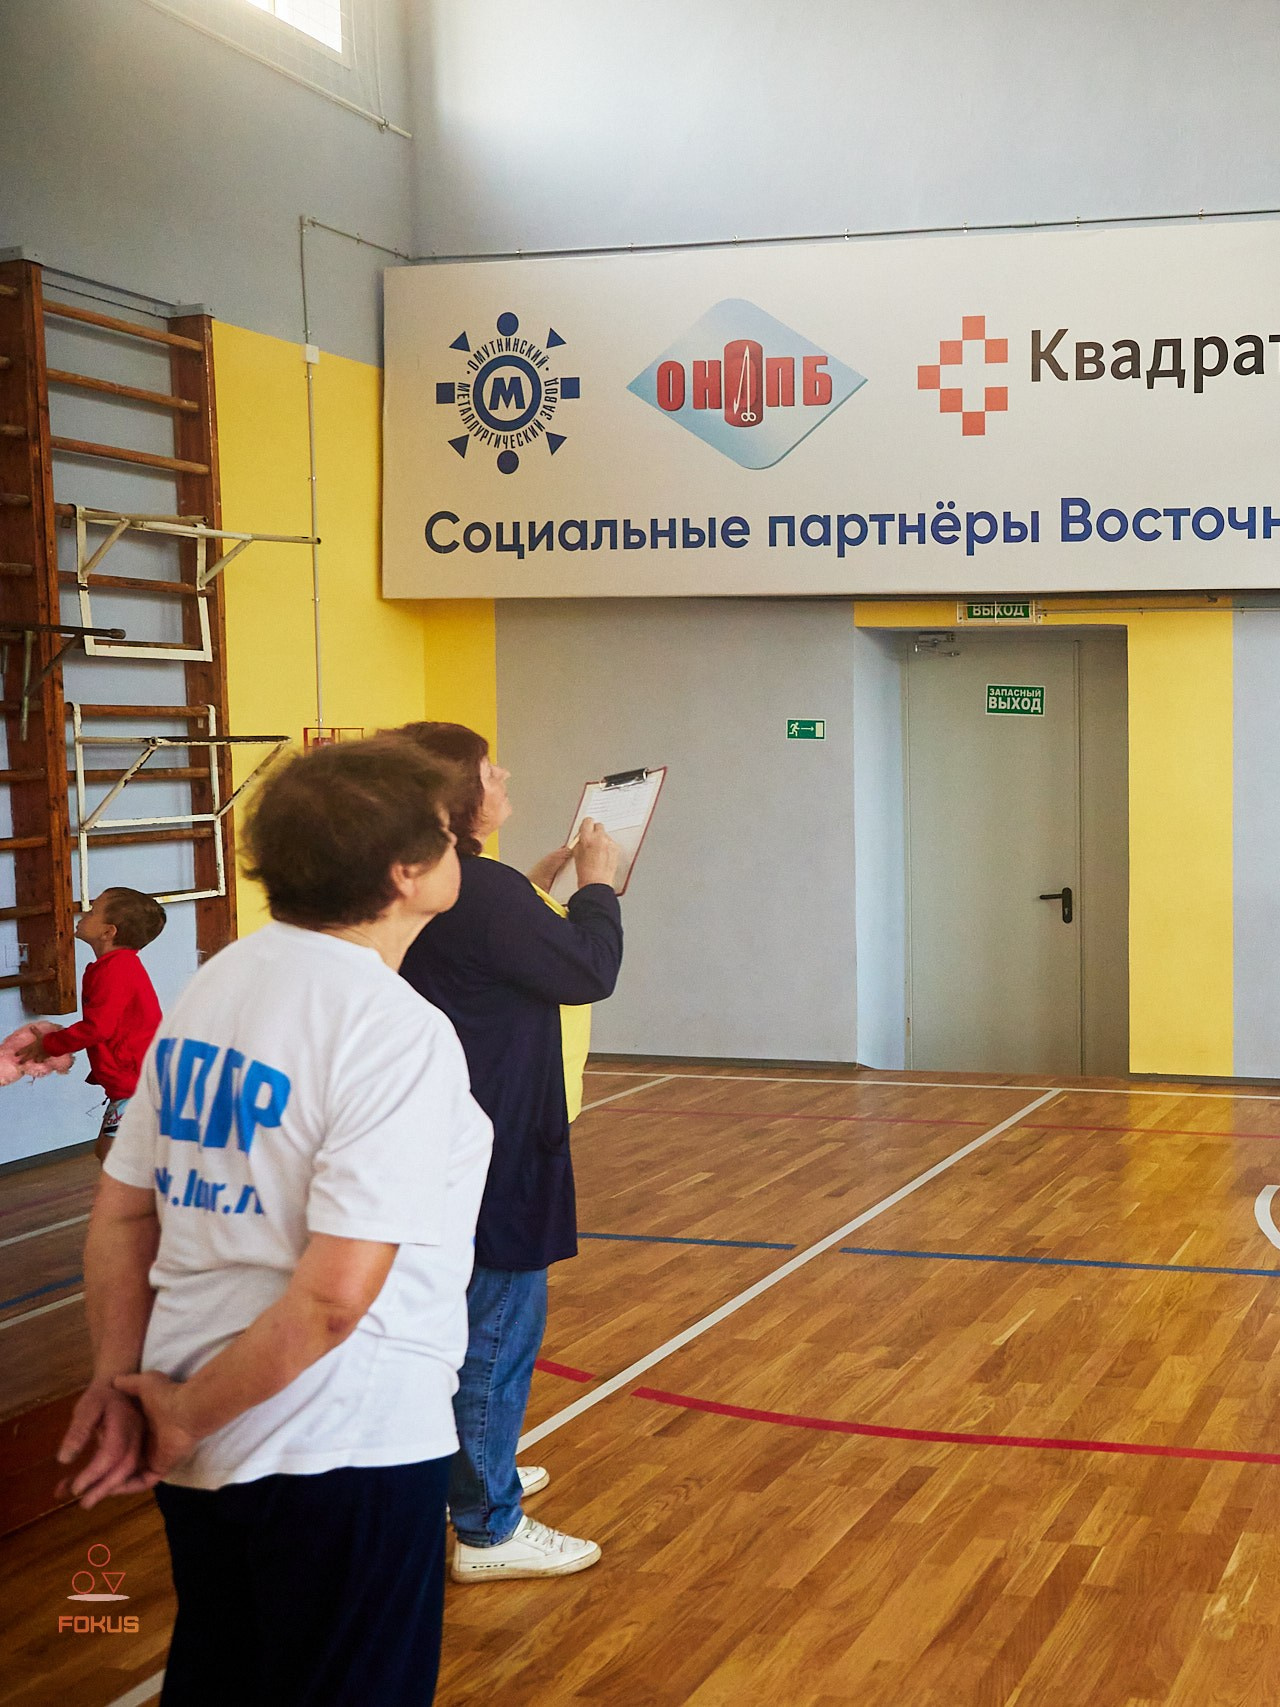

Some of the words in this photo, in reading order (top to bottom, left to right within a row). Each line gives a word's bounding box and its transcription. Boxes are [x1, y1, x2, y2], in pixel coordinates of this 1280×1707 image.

[467, 337, 550, 371] ОМУТНИНСКИЙ
[456, 382, 546, 449] МЕТАЛЛУРГИЧЕСКИЙ
[539, 376, 560, 421] ЗАВОД
[424, 511, 751, 559] Социальные
[768, 501, 1040, 557] партнёры
[988, 696, 1042, 713] ВЫХОД
[989, 687, 1042, 698] ЗАПАСНЫЙ
